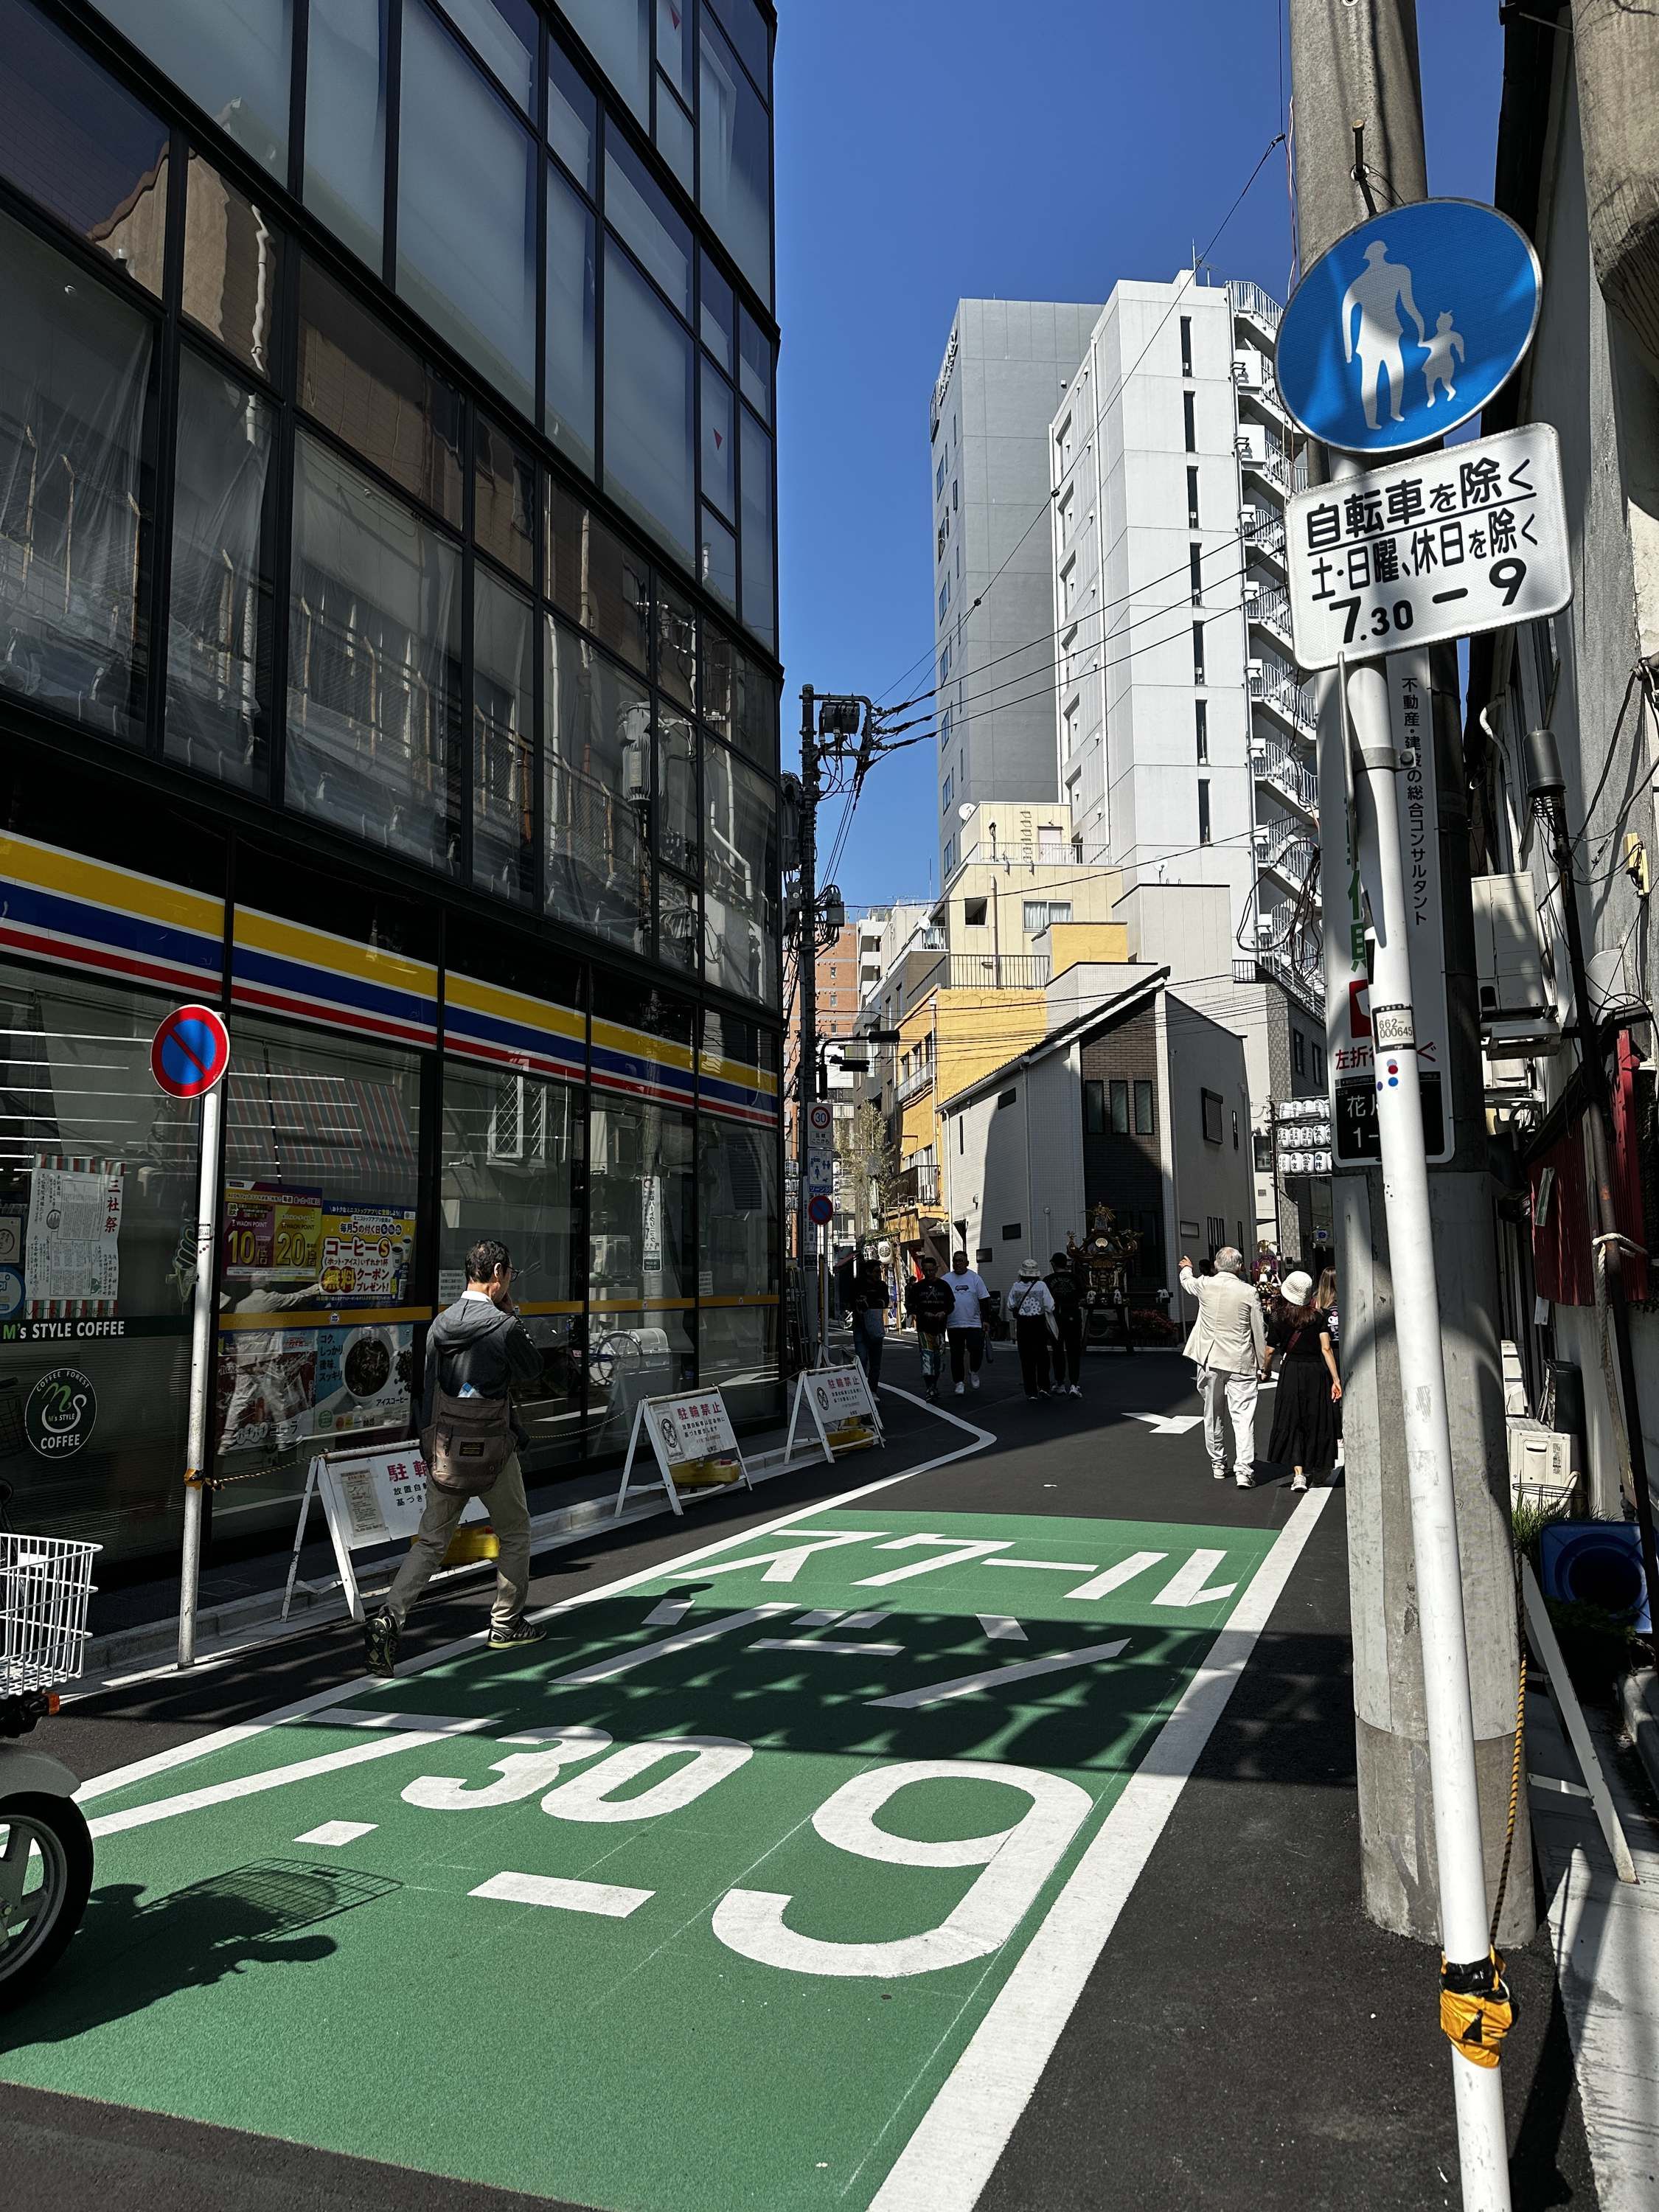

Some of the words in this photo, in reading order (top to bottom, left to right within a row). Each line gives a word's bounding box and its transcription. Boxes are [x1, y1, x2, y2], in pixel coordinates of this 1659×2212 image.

[1307, 457, 1534, 549] 自転車を除く
[1312, 507, 1538, 600] 土・日曜、休日を除く
[1380, 1027, 1413, 1039] 000645
[1335, 1042, 1436, 1070] 左折ぐ
[815, 1112, 827, 1123] 30
[105, 1180, 121, 1233] 三社祭
[227, 1230, 256, 1265] 10
[276, 1232, 306, 1266] 20
[357, 1268, 389, 1281] クーポン
[32, 1322, 72, 1338] STYLE
[77, 1321, 125, 1337] COFFEE
[36, 1371, 61, 1393] COFFEE
[66, 1370, 90, 1390] FOREST
[376, 1397, 408, 1407] アイスコーヒー
[677, 1401, 722, 1420] 駐輪禁止
[59, 1413, 76, 1422] STYLE
[41, 1433, 80, 1450] COFFEE
[664, 1528, 1239, 1607] スクール
[547, 1598, 1134, 1710] ゾーン
